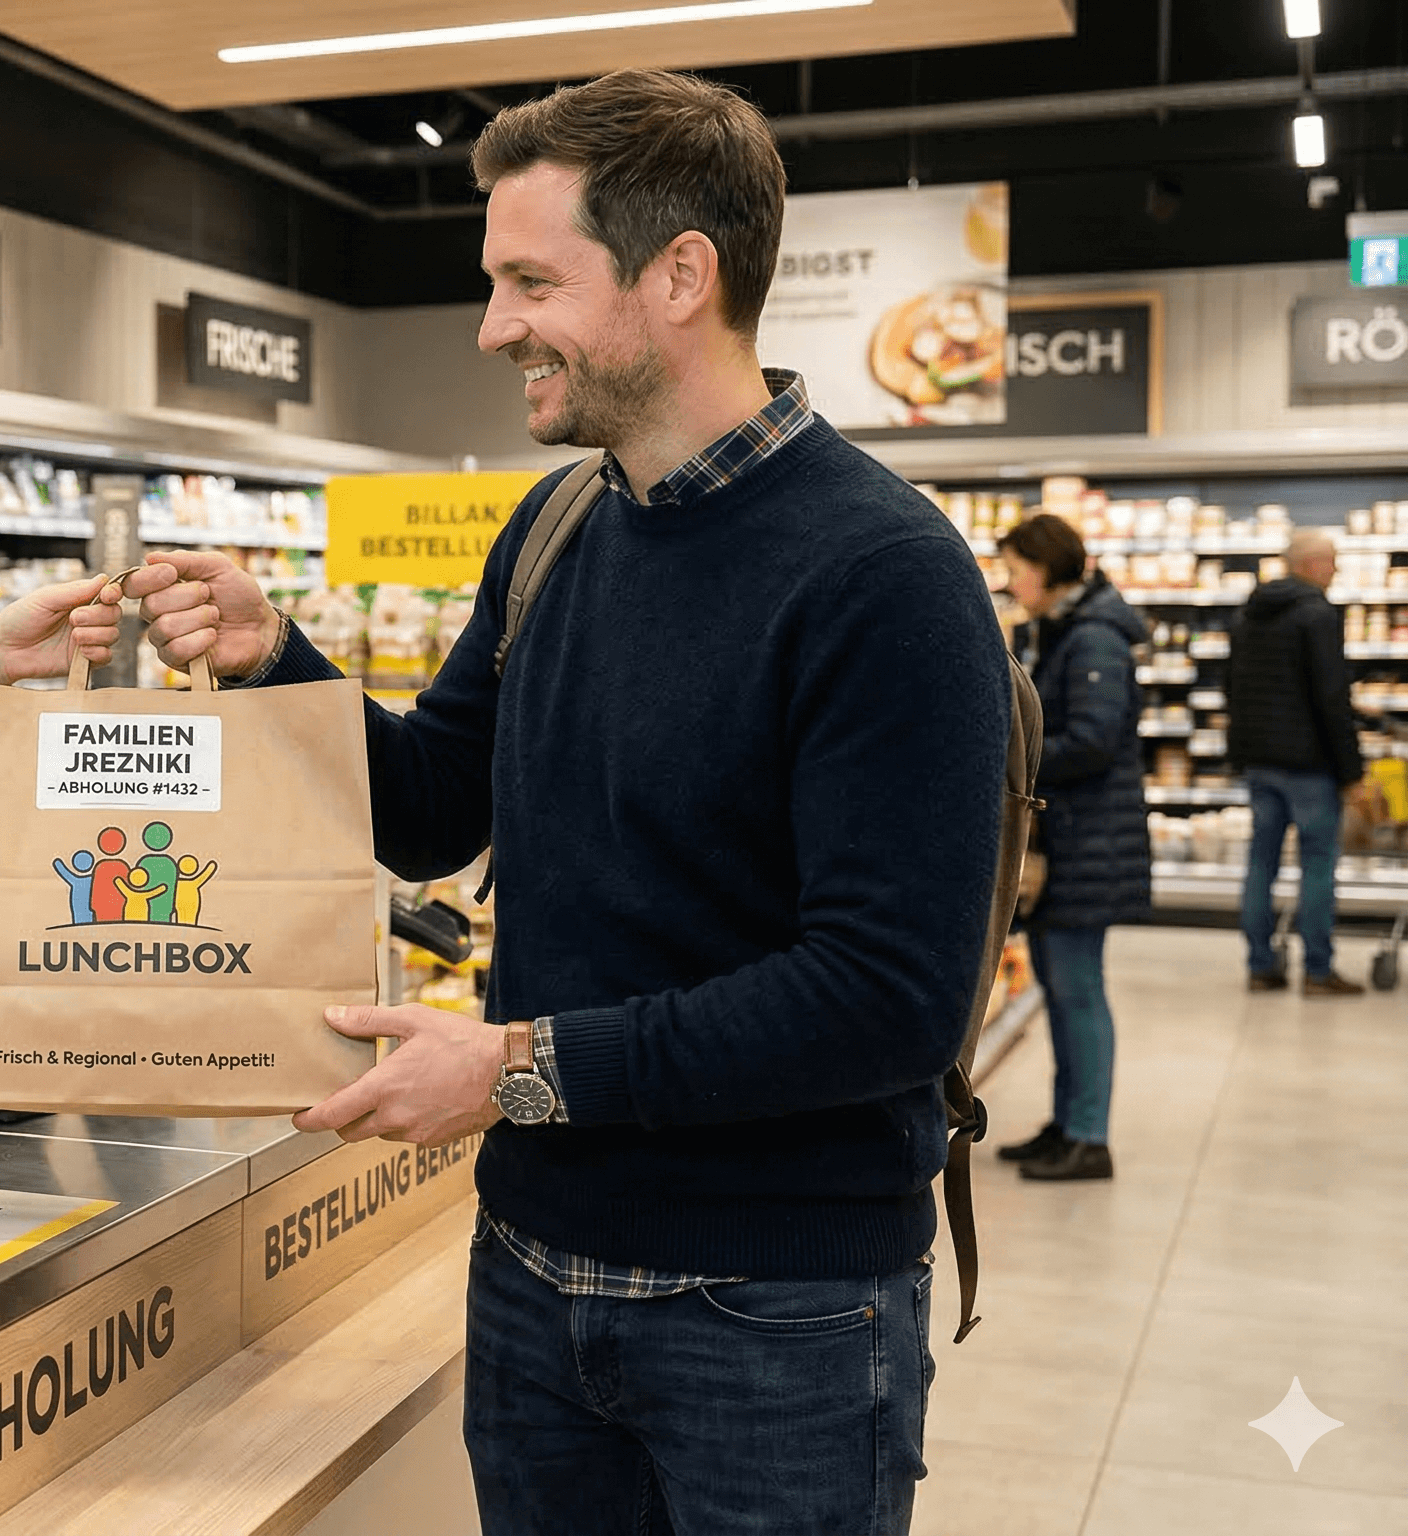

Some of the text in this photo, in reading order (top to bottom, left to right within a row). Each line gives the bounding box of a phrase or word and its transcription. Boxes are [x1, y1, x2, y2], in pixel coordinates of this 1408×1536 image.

[1326, 304, 1408, 364] RÖ
[206, 318, 300, 384] FRISCHE
[64, 724, 194, 746] FAMILIEN
[65, 752, 191, 774] JREZNIKI
[58, 781, 149, 794] ABHOLUNG
[152, 783, 198, 795] #1432
[18, 941, 252, 974] LUNCHBOX
[47, 1051, 59, 1065] &
[63, 1051, 137, 1069] Regional
[151, 1052, 203, 1068] Guten
[206, 1053, 276, 1071] Appetit!
[265, 1149, 410, 1281] BESTELLUNG
